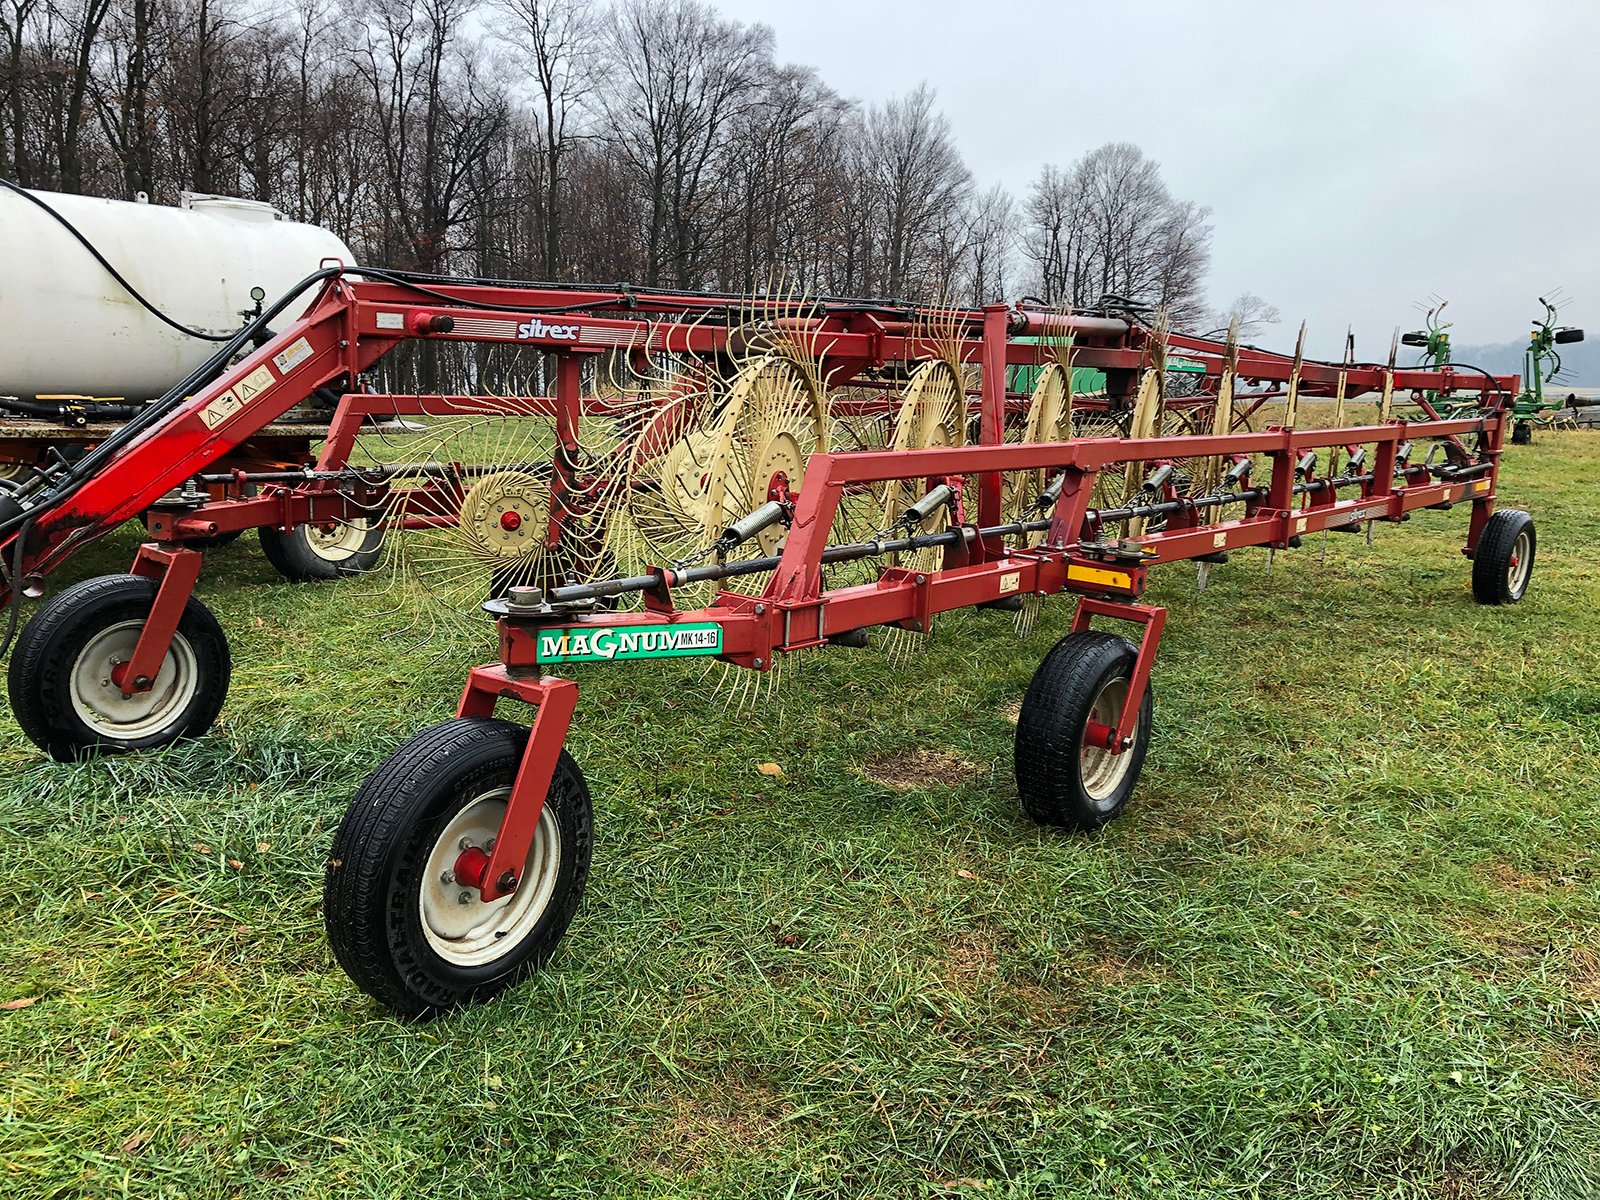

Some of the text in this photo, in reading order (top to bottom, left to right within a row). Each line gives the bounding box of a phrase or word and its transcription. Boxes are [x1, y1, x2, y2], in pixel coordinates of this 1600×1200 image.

[518, 318, 580, 340] sitrex
[541, 629, 716, 659] MAGNUM MK 14-16
